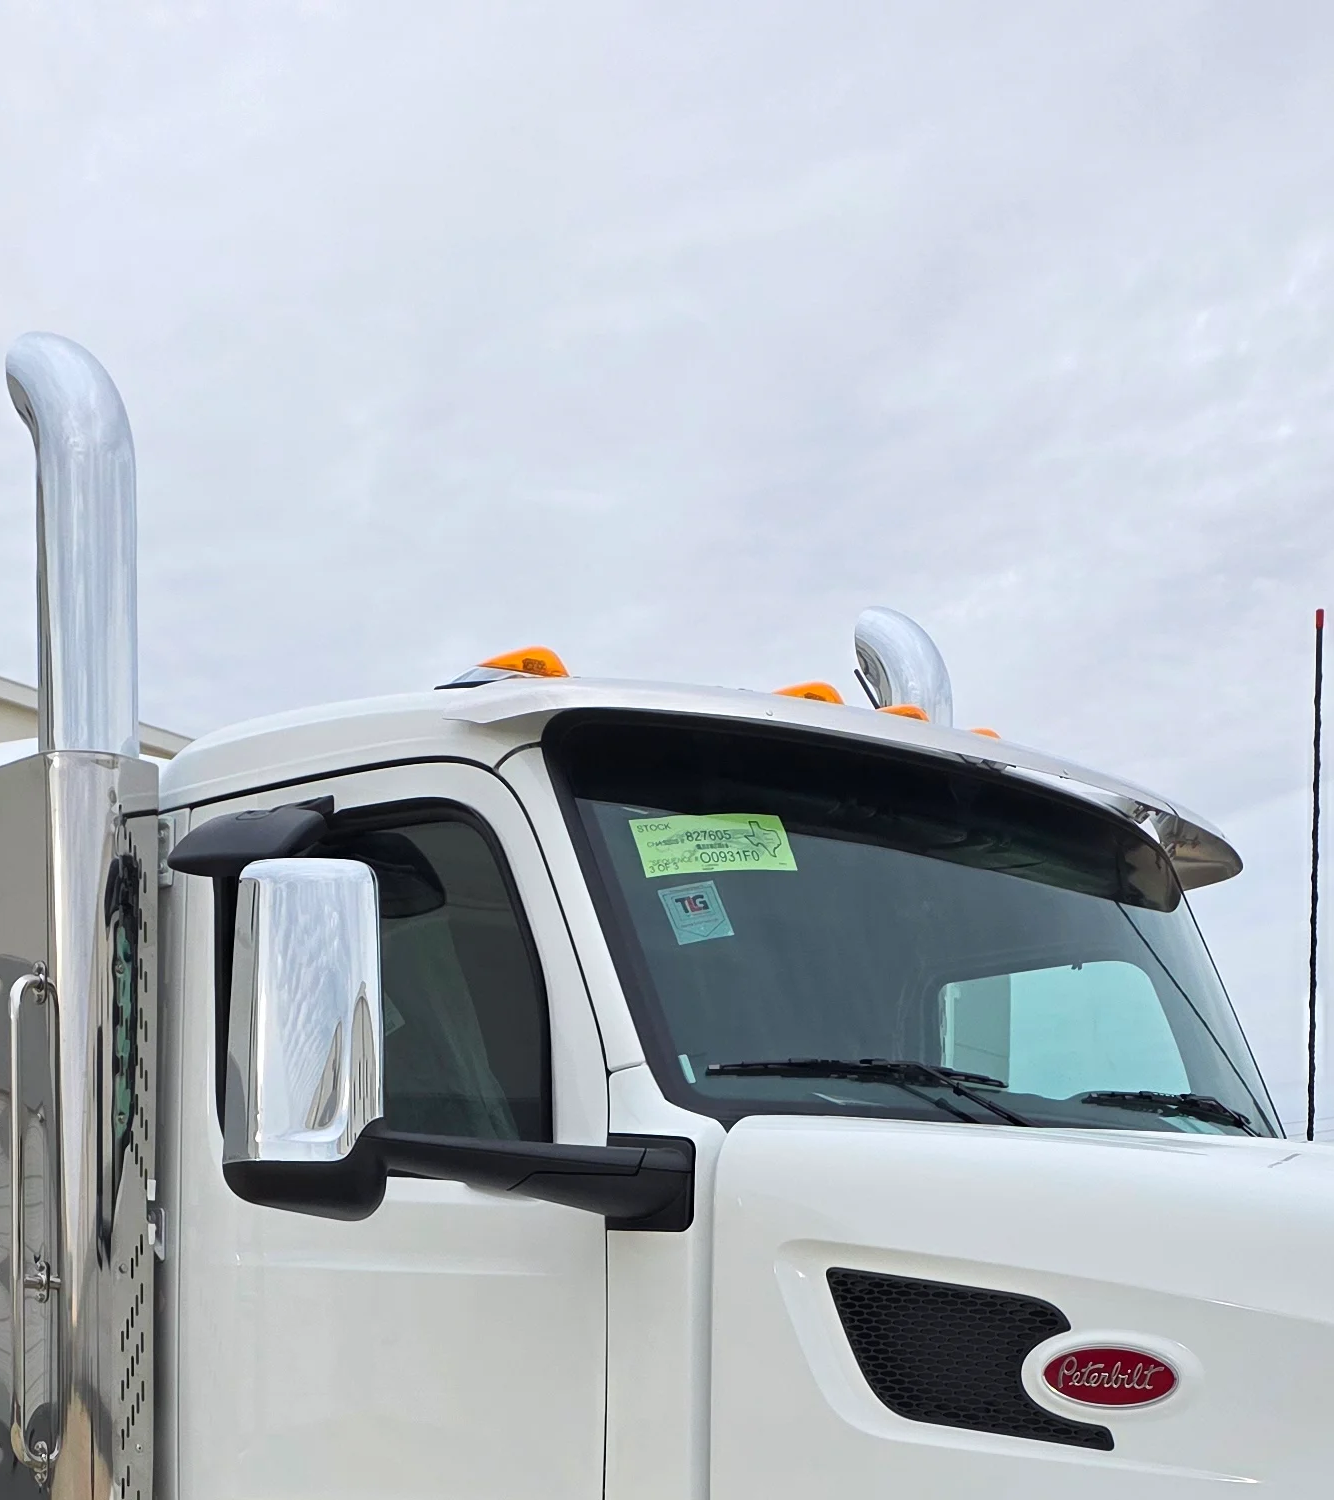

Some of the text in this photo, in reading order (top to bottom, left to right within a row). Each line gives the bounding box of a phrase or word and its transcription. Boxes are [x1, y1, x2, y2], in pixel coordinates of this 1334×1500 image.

[636, 822, 672, 833] STOCK
[685, 829, 732, 842] 827605
[649, 862, 680, 874] 3 OF 3
[1058, 1356, 1164, 1390] Peterbilt
